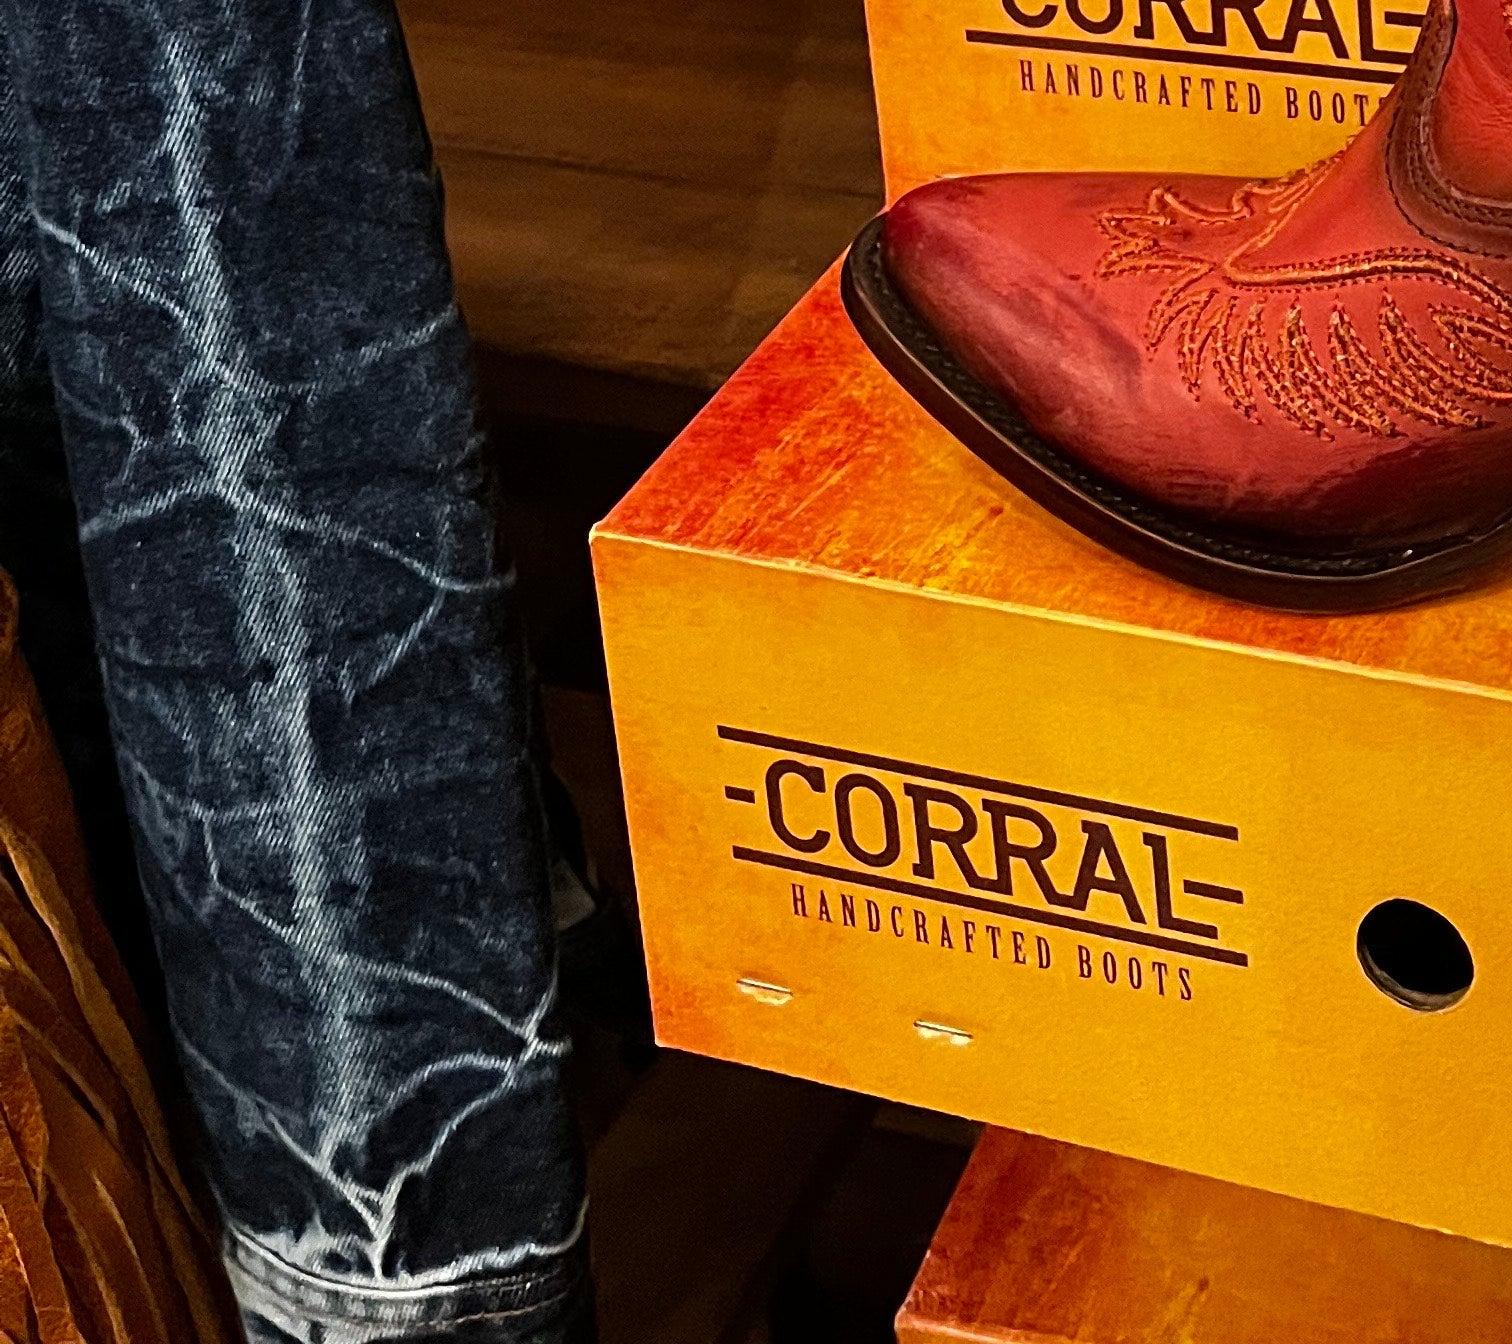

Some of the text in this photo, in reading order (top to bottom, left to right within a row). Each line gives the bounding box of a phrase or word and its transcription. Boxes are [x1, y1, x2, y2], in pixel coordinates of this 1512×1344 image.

[1020, 59, 1261, 116] HANDCRAFTED
[790, 884, 1193, 1000] HANDCRAFTED BOOTS
